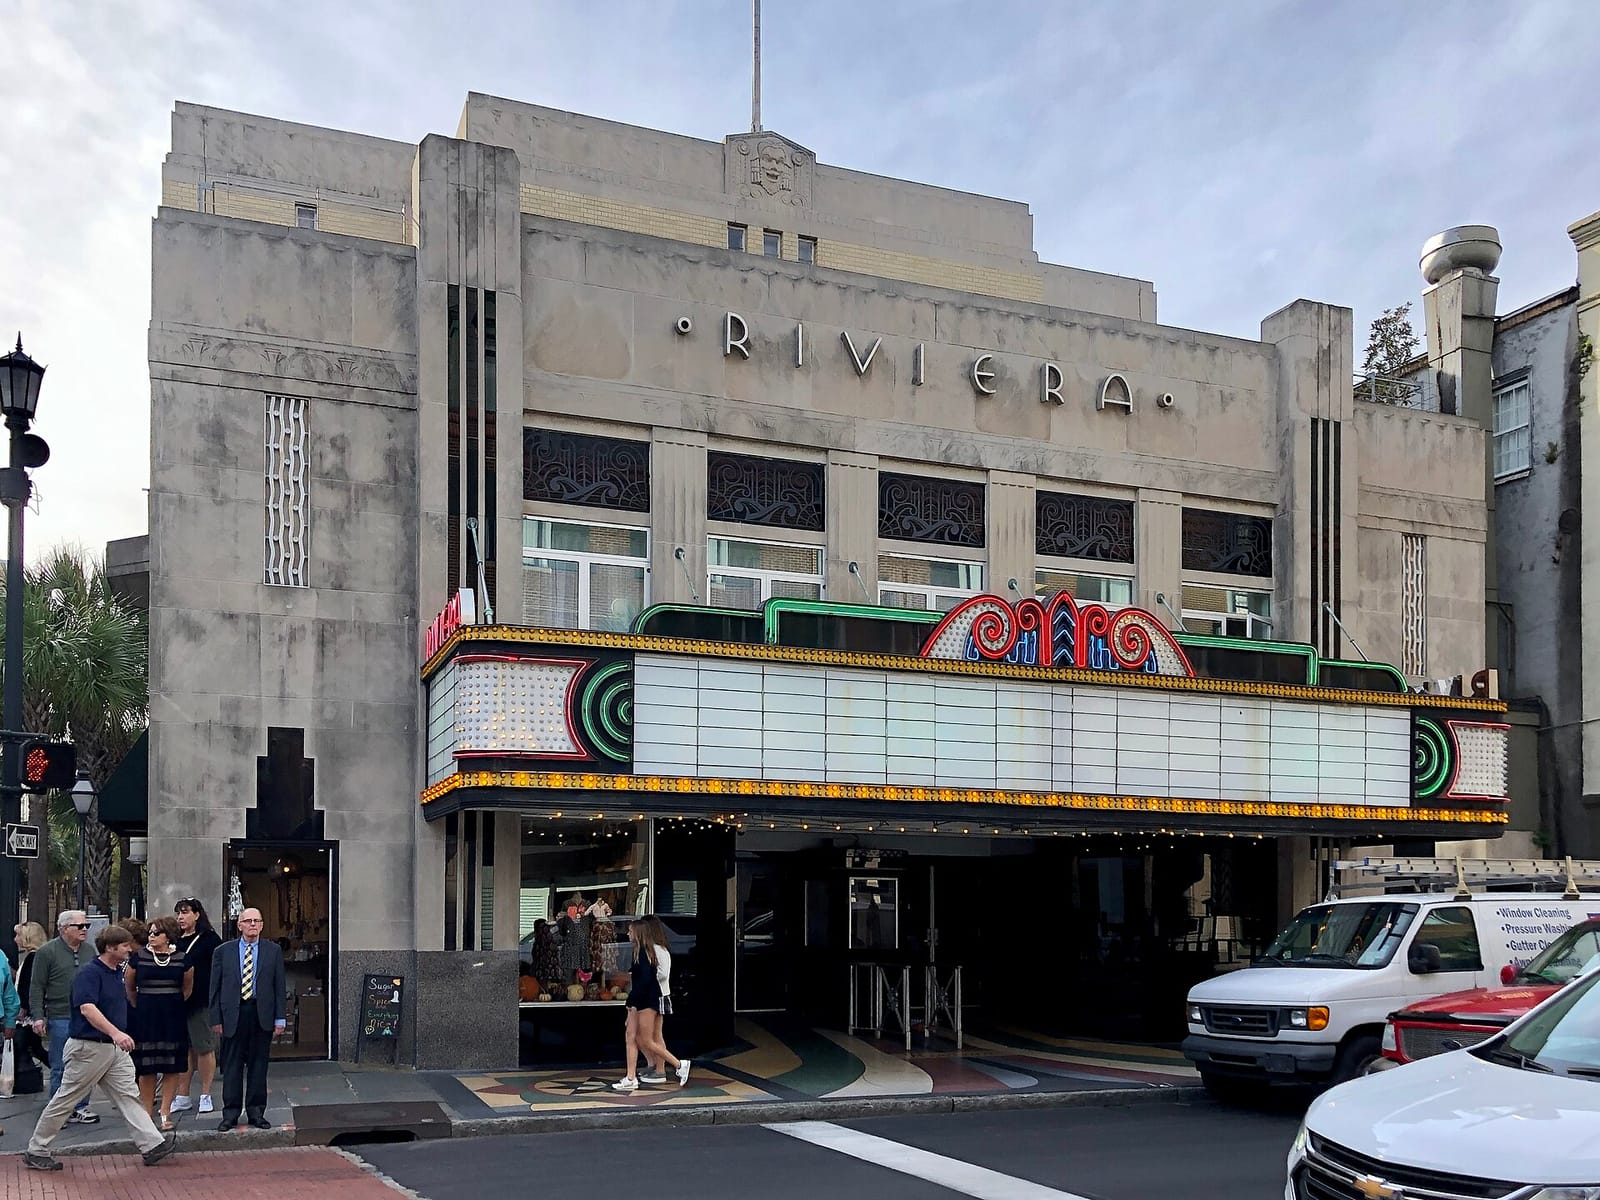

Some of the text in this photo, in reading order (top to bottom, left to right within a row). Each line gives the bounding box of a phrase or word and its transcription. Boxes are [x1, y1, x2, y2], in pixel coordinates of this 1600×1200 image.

[723, 311, 1134, 416] RIVIERA
[16, 835, 35, 848] ONE WAY
[1533, 907, 1572, 919] Cleaning
[369, 978, 394, 991] Sugar
